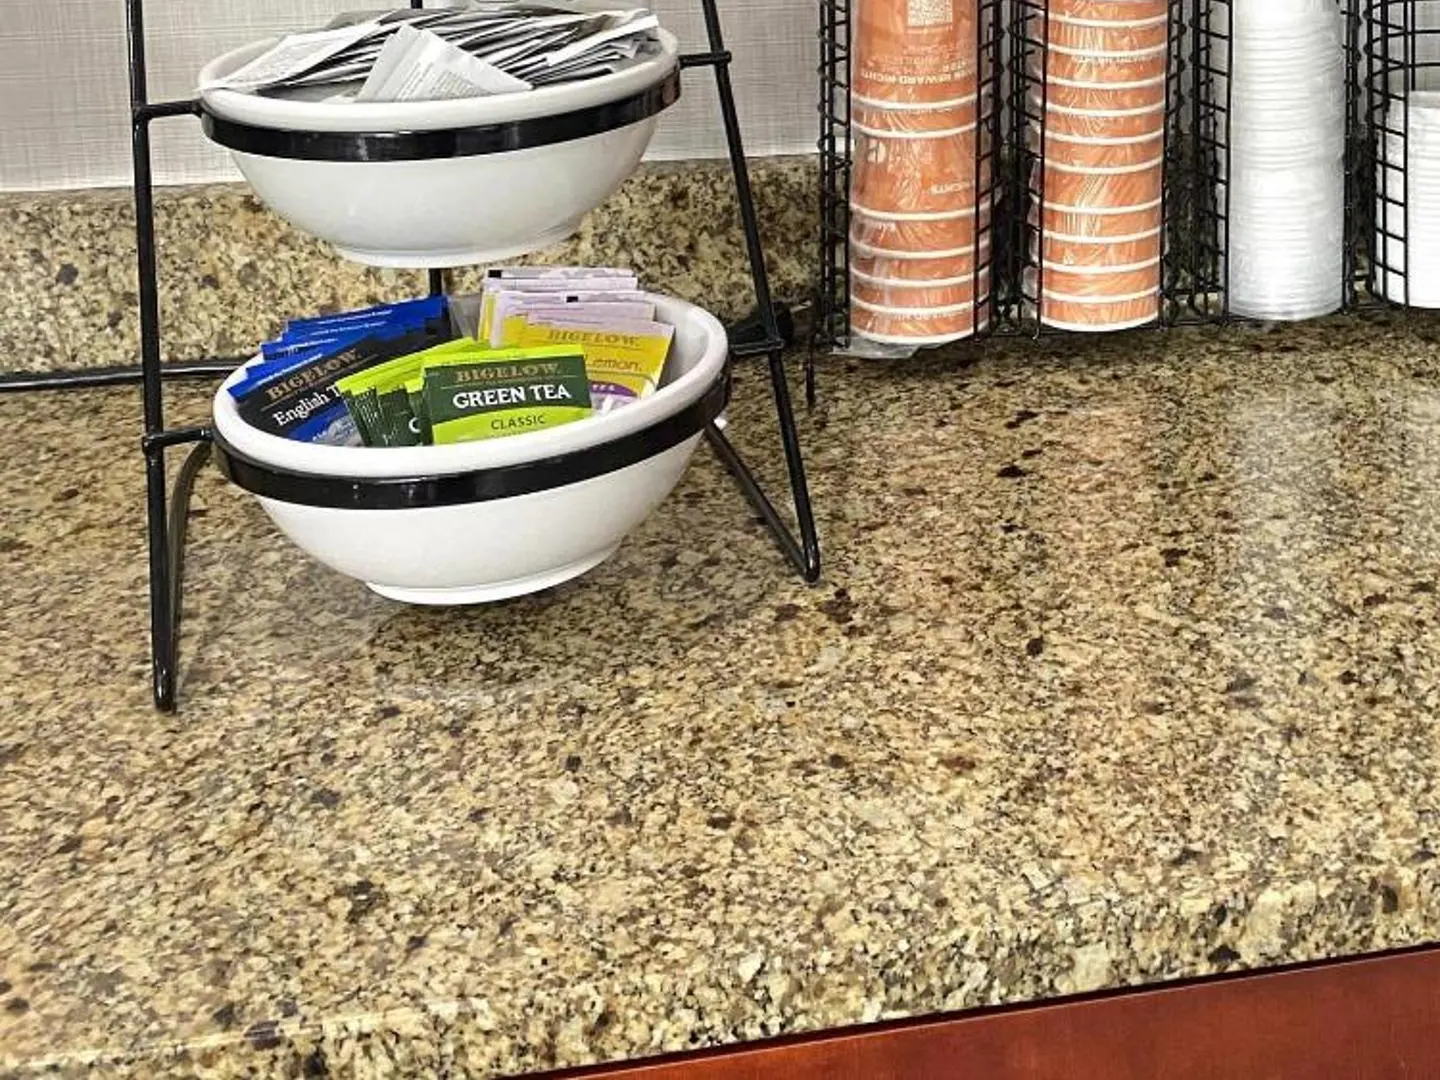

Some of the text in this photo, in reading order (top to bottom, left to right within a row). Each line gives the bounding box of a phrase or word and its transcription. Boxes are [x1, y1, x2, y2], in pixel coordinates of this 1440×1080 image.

[265, 348, 359, 401] BIGELOW
[456, 363, 559, 383] BIGELOW
[272, 390, 330, 426] English
[452, 384, 573, 409] GREEN TEA
[491, 415, 546, 431] CLASSIC
